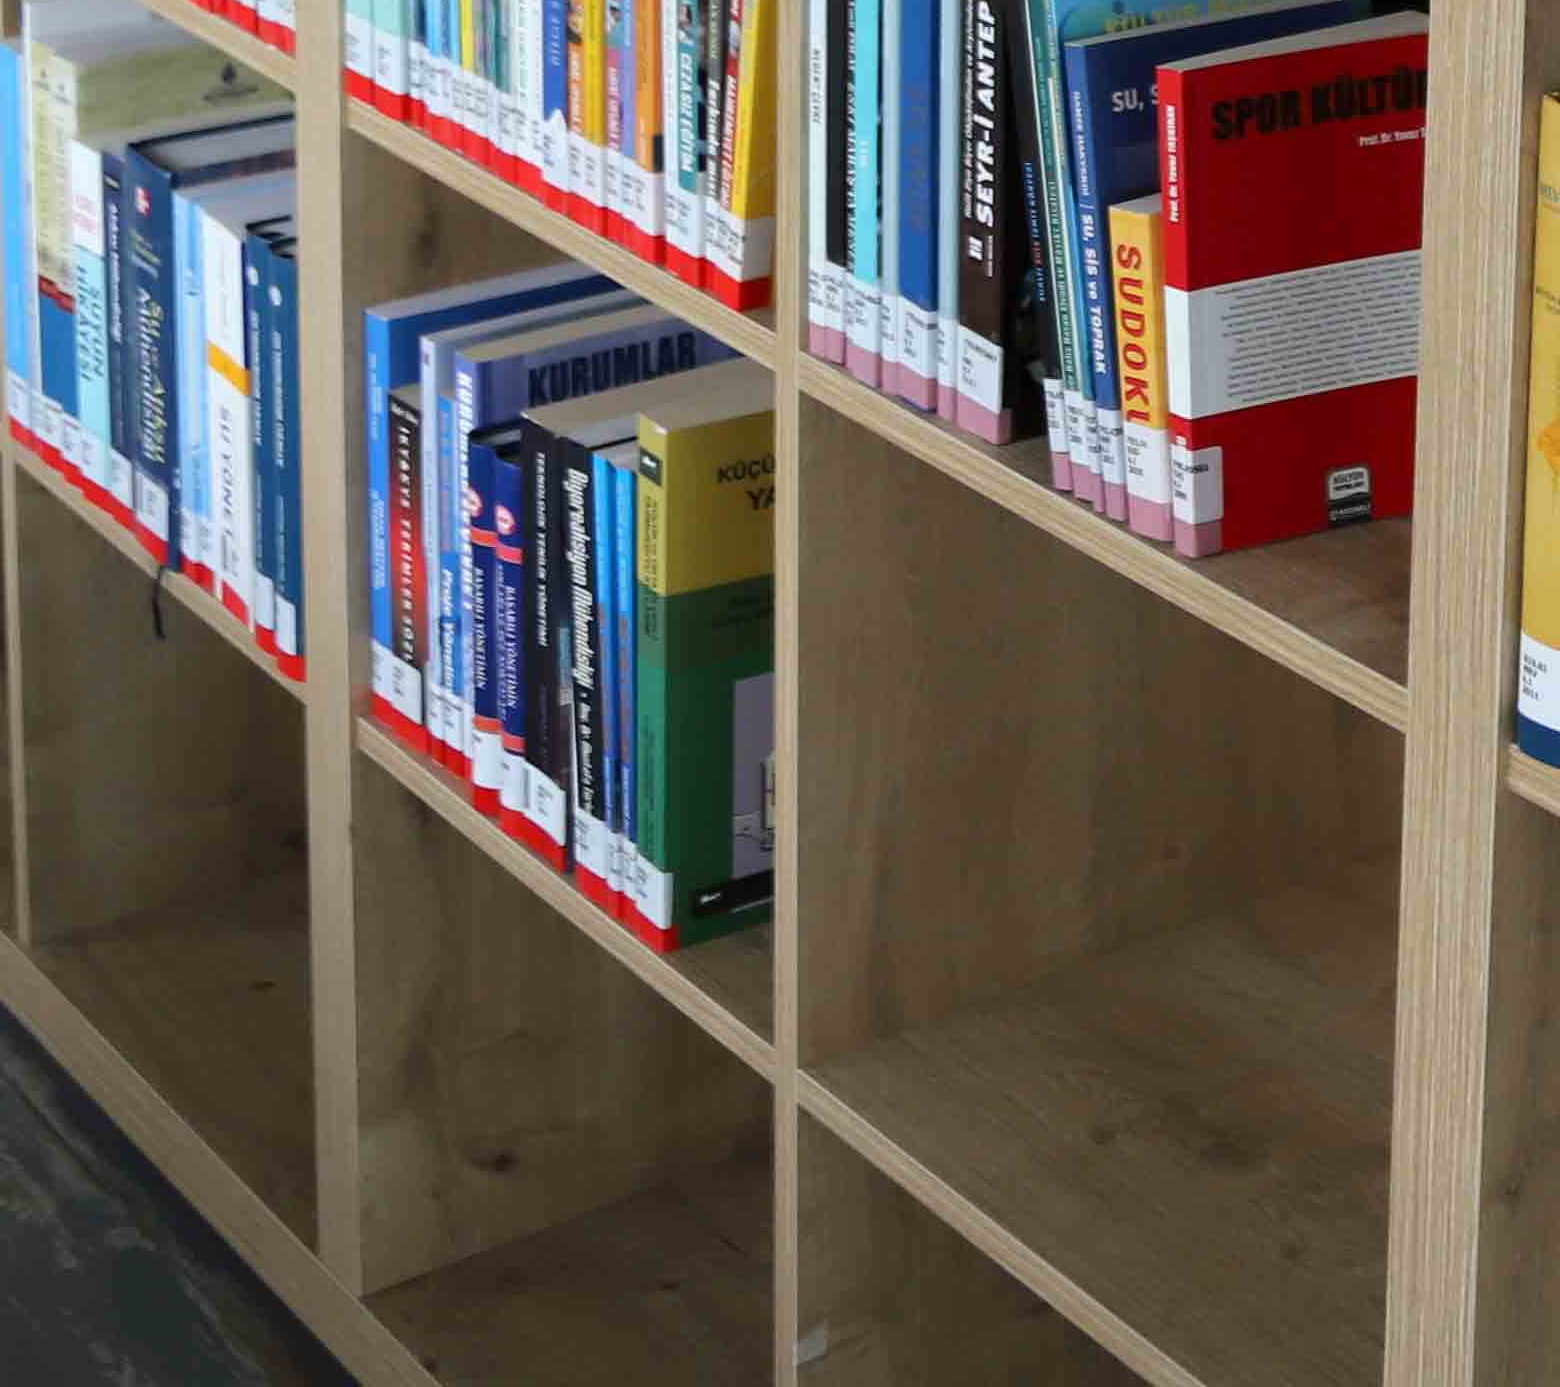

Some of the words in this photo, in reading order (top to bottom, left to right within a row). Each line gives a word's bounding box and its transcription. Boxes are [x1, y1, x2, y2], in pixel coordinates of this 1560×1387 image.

[975, 0, 998, 110] ANTEP
[1111, 88, 1144, 112] SU,
[1212, 89, 1303, 141] SPOR
[974, 113, 998, 227] SEYR-İ
[528, 331, 698, 408] KURUMLAR
[1091, 304, 1106, 375] TOPRAK
